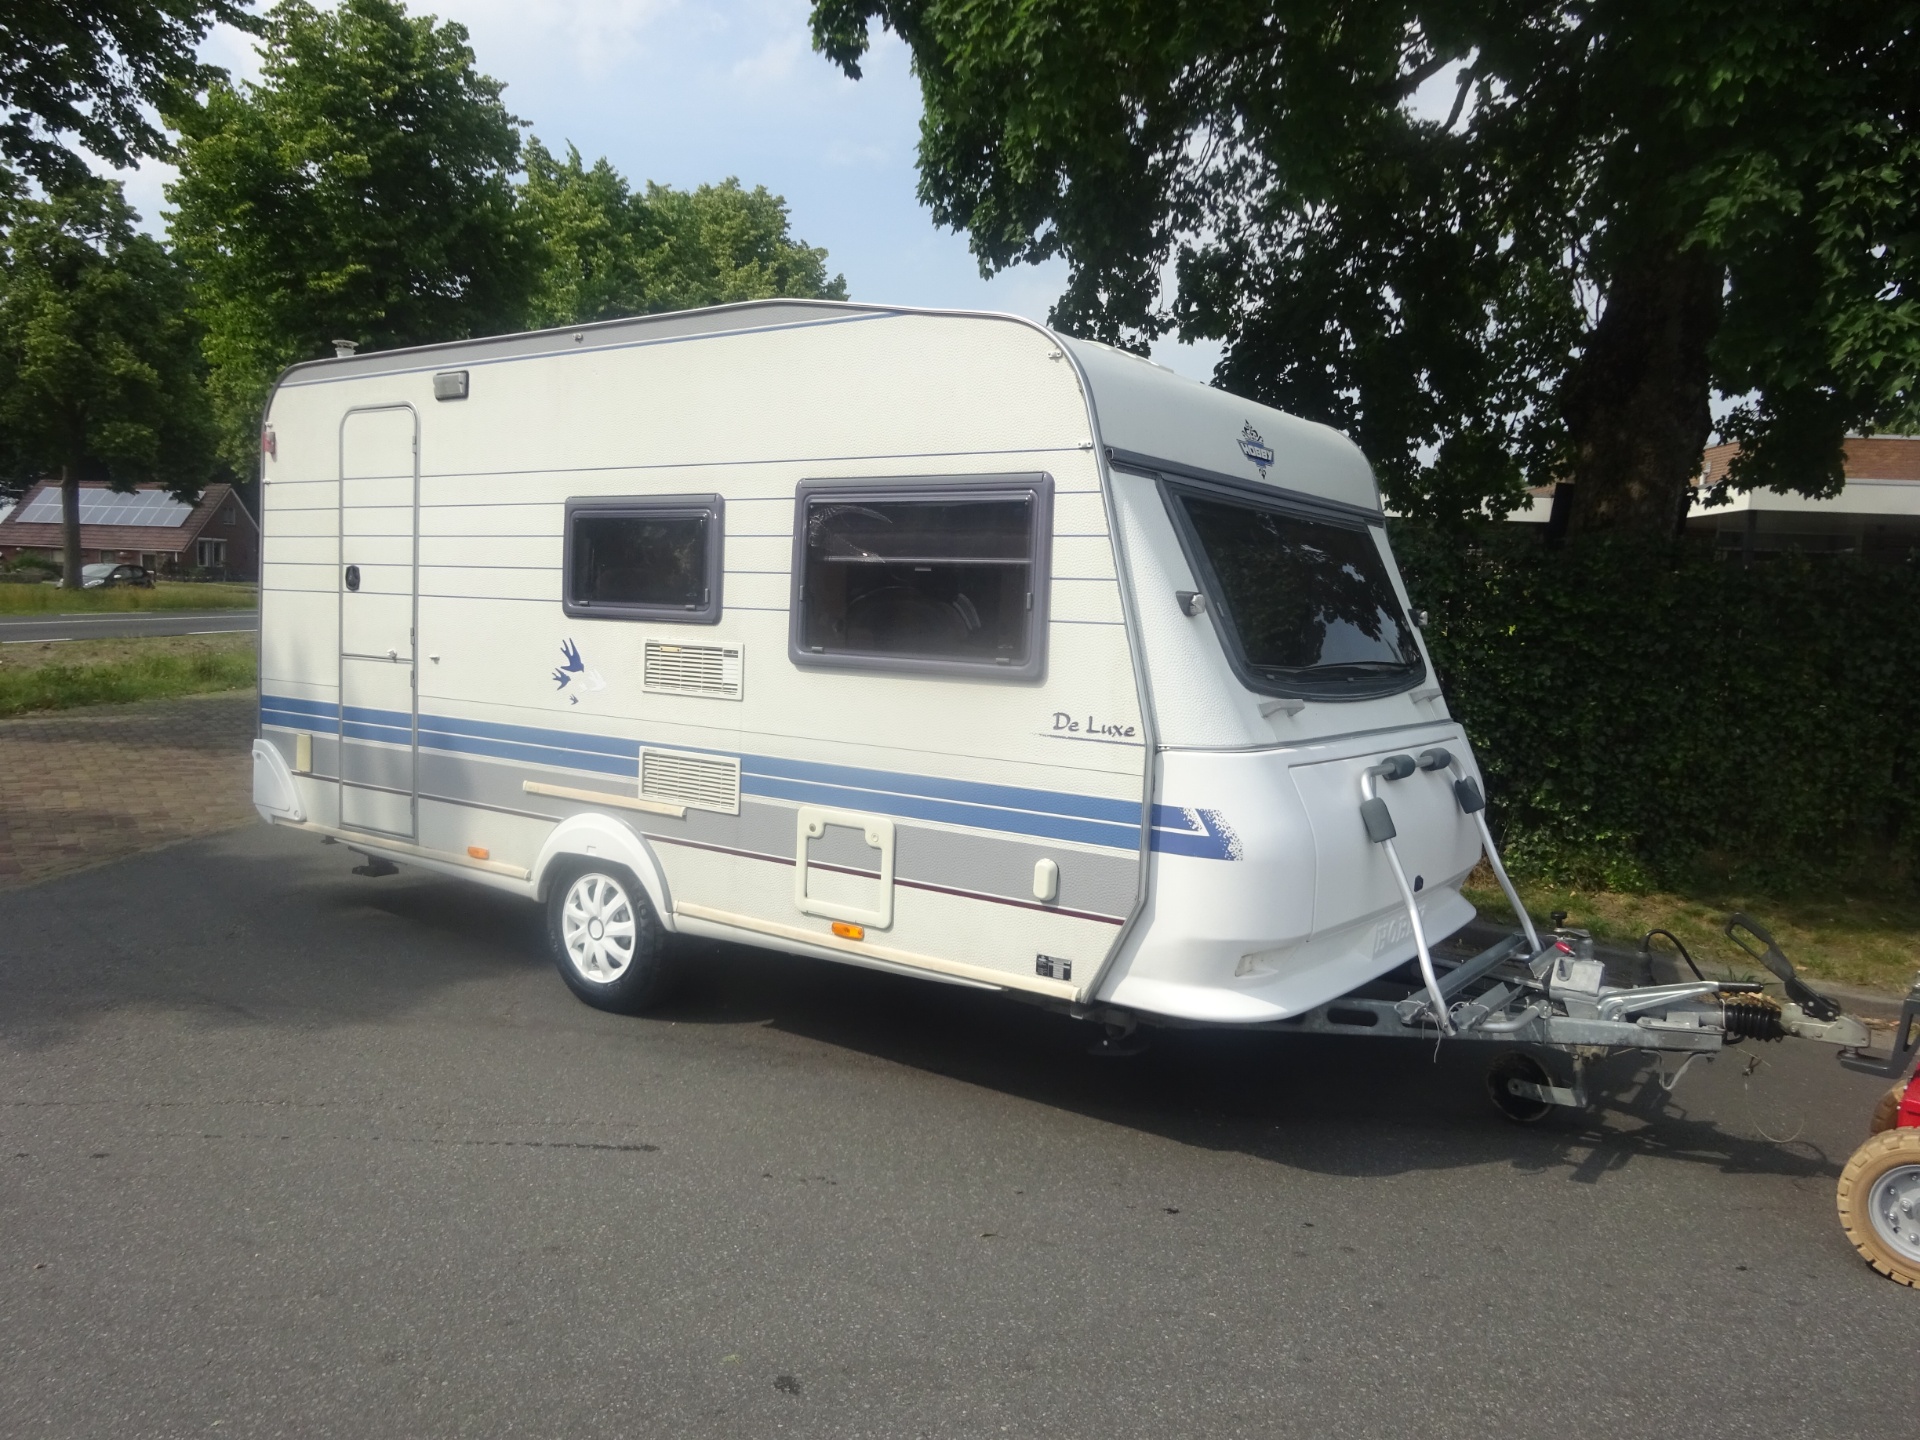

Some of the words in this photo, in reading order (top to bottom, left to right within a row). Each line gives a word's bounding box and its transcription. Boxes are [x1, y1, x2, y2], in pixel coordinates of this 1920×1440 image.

[1240, 441, 1273, 461] HOBBY
[1053, 712, 1079, 732] De
[1086, 716, 1136, 737] Luxe
